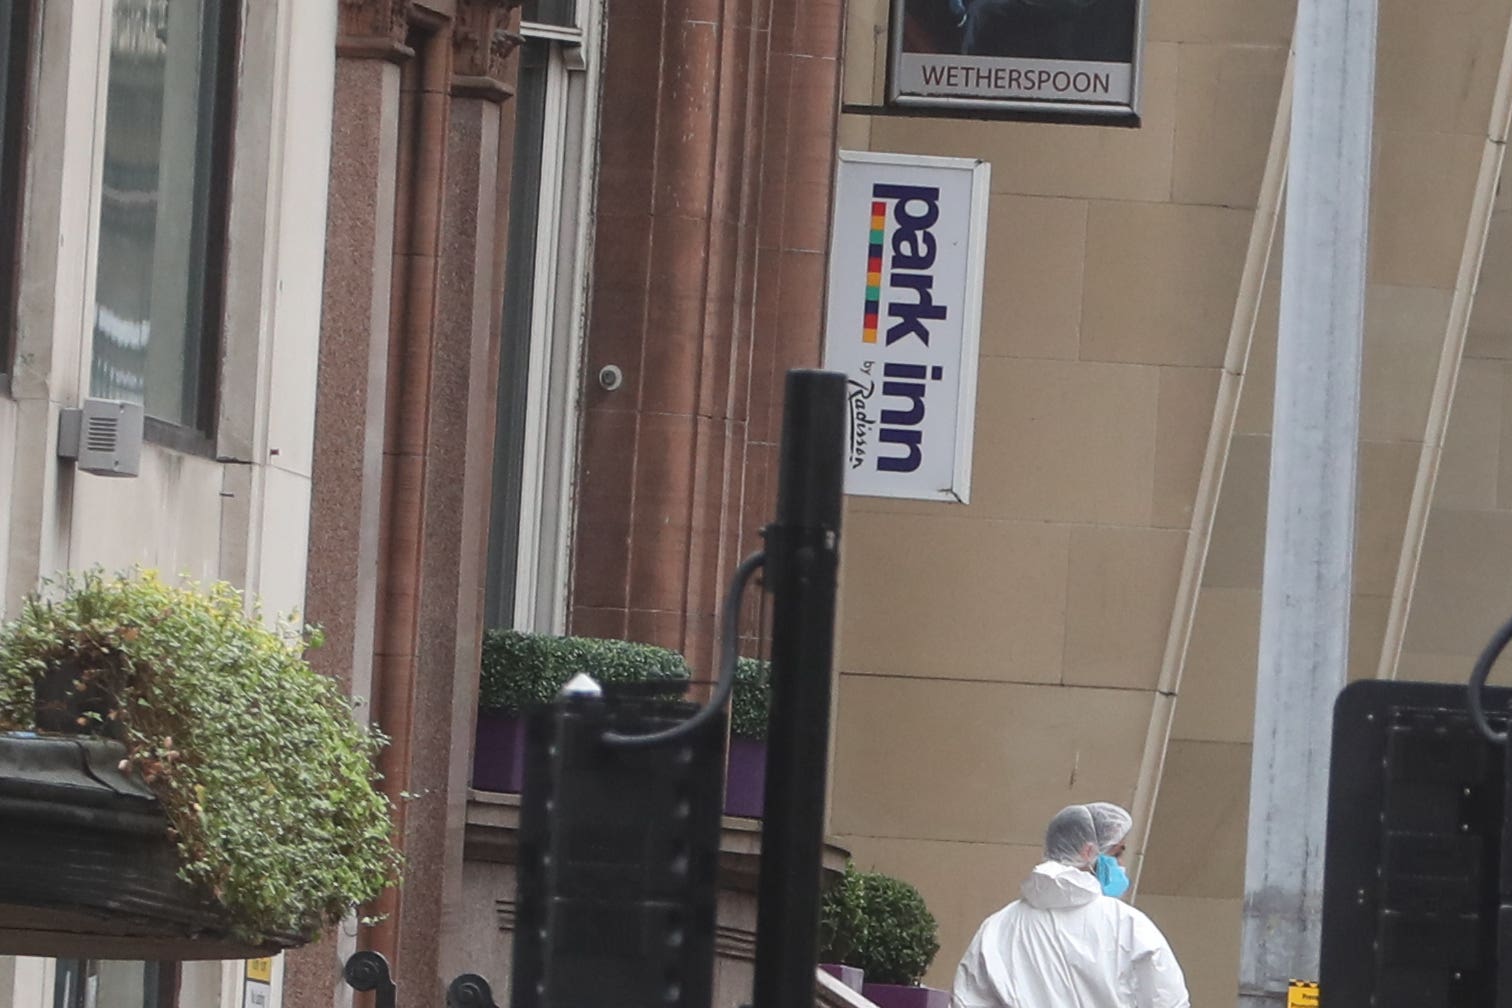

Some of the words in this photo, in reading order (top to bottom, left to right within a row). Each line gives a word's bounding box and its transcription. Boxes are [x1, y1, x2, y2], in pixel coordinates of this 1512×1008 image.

[922, 64, 1111, 95] WETHERSPOON
[872, 182, 948, 349] park
[860, 360, 876, 377] by
[847, 379, 877, 470] Radisson
[876, 361, 944, 474] inn
